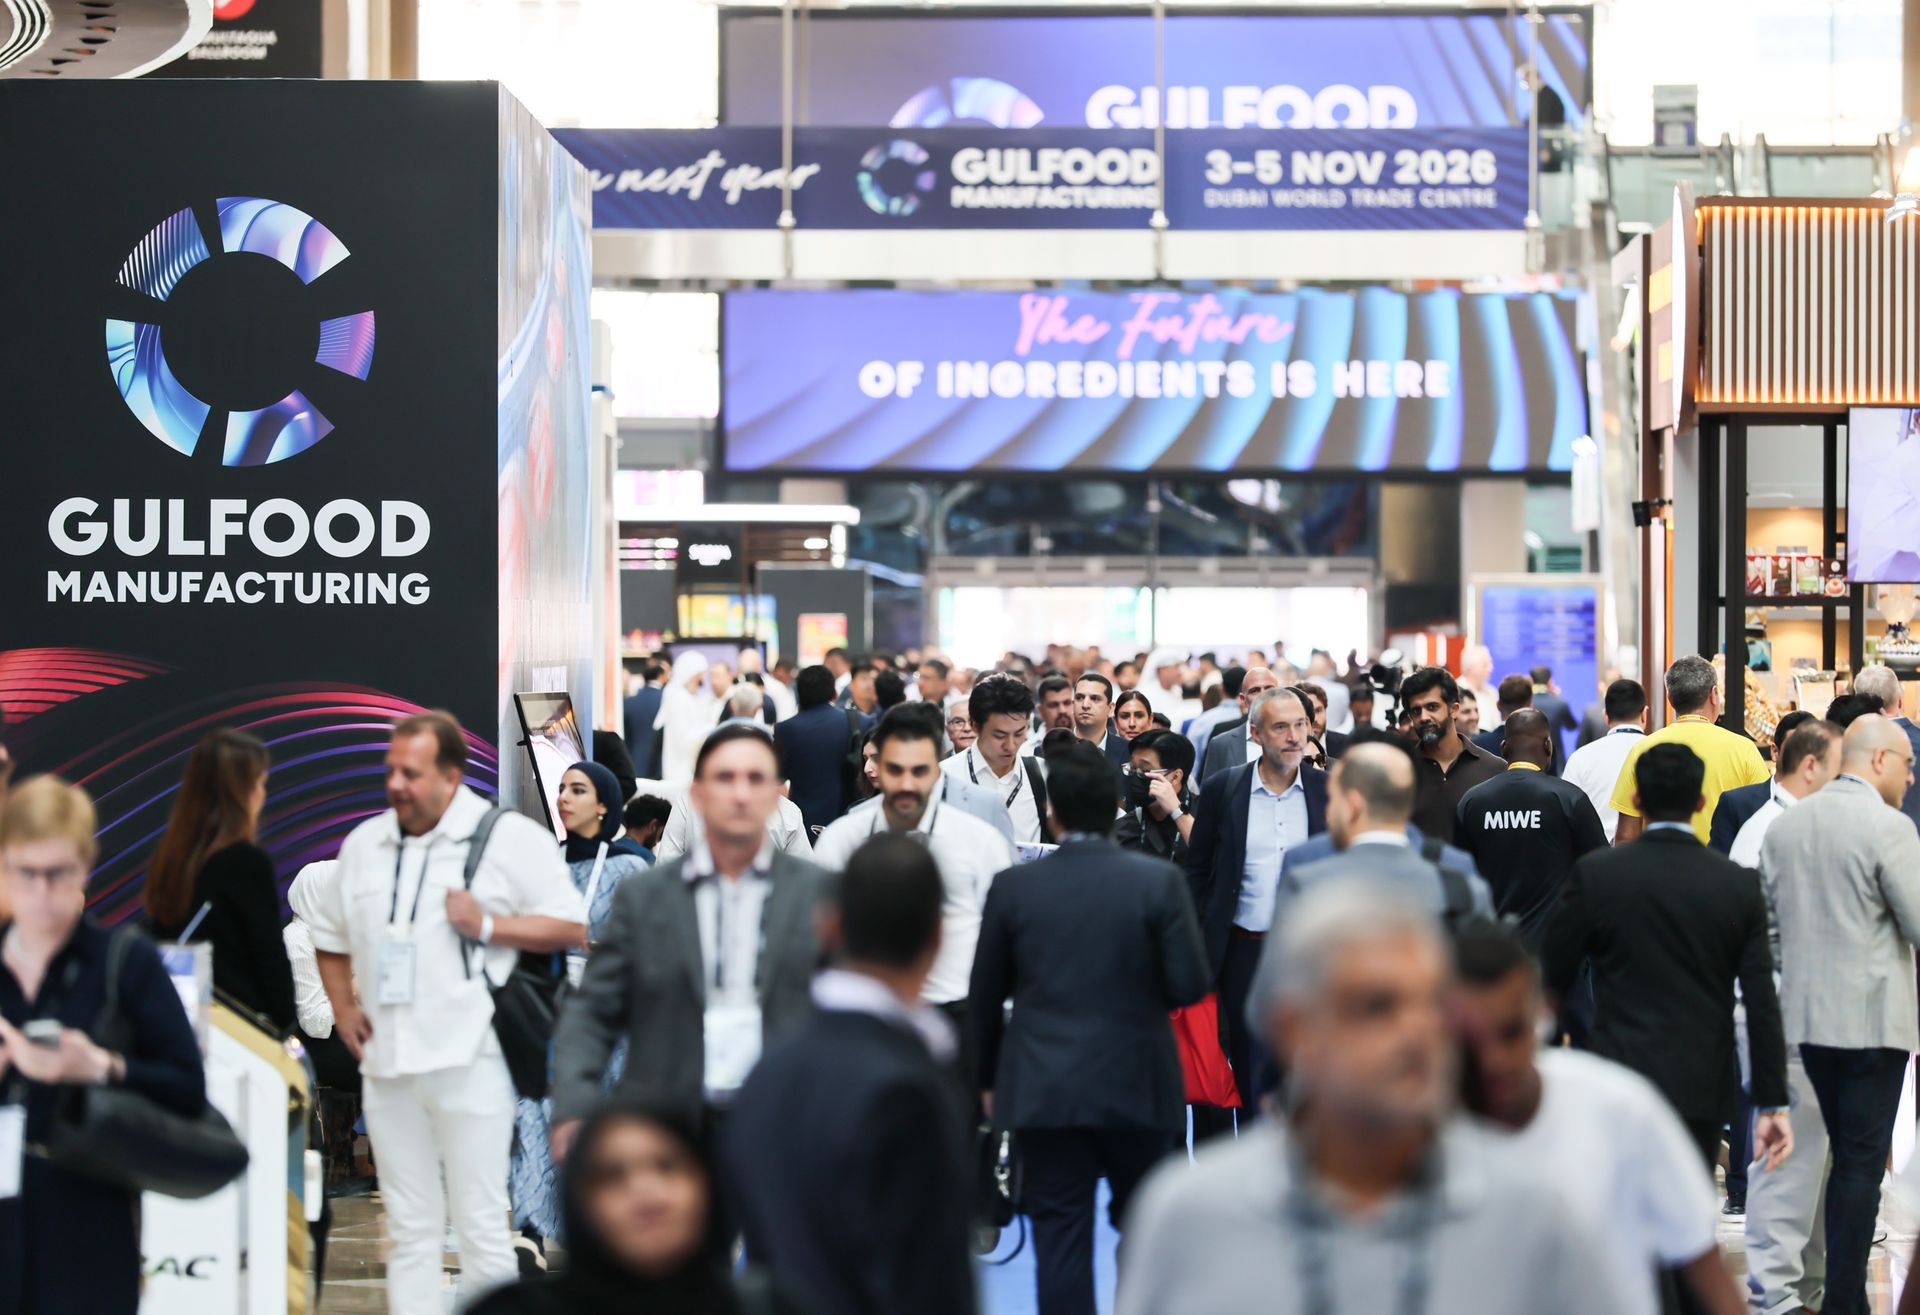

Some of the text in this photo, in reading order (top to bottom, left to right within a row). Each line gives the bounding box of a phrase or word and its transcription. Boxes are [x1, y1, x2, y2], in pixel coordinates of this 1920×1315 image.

[615, 149, 726, 200] next
[720, 163, 821, 205] year
[950, 147, 1160, 185] GULFOOD
[1290, 150, 1387, 186] NOV
[1393, 149, 1498, 186] 2026
[950, 185, 1160, 209] MANUFACTURING
[1203, 188, 1498, 209] DUBAI WORLD TRADE CENTRE
[1014, 291, 1295, 360] The Future
[858, 359, 1451, 398] OF INGREDIENTS IS HERE
[48, 496, 431, 558] GULFOOD
[47, 570, 431, 605] MANUFACTURING
[1484, 810, 1541, 829] MIWE
[140, 1255, 218, 1280] AC
